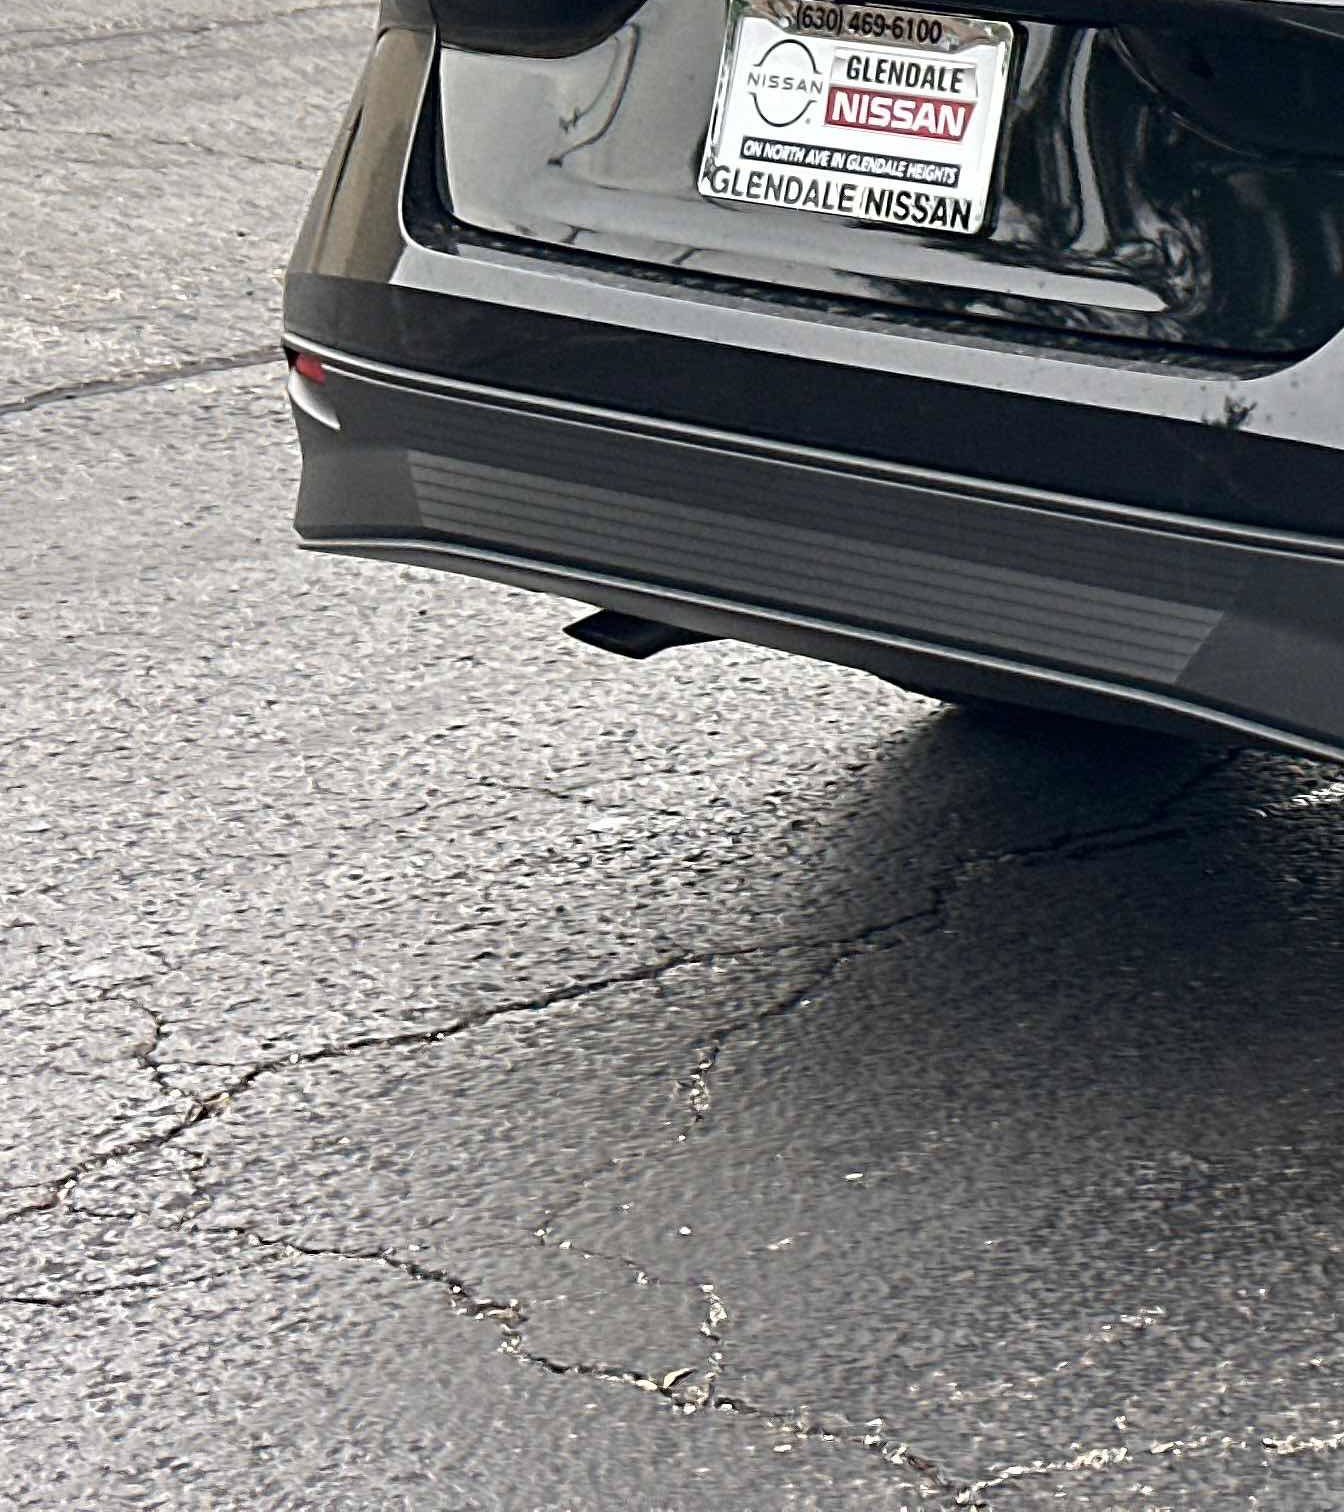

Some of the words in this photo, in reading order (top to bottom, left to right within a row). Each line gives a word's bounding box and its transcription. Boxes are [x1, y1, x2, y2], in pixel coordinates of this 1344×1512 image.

[796, 3, 844, 36] (630)
[848, 10, 943, 44] 469-6100
[747, 71, 824, 95] NISSAN
[846, 55, 965, 94] GLENDALE
[832, 90, 966, 138] NISSAN
[743, 139, 763, 158] ON
[763, 141, 804, 163] NORTH
[806, 148, 830, 167] AVE
[830, 152, 846, 170] IN
[846, 154, 907, 178] GLENDALE
[906, 163, 958, 185] HEIGHTS
[710, 163, 858, 214] GLENDALE
[864, 186, 973, 232] NISSAN
